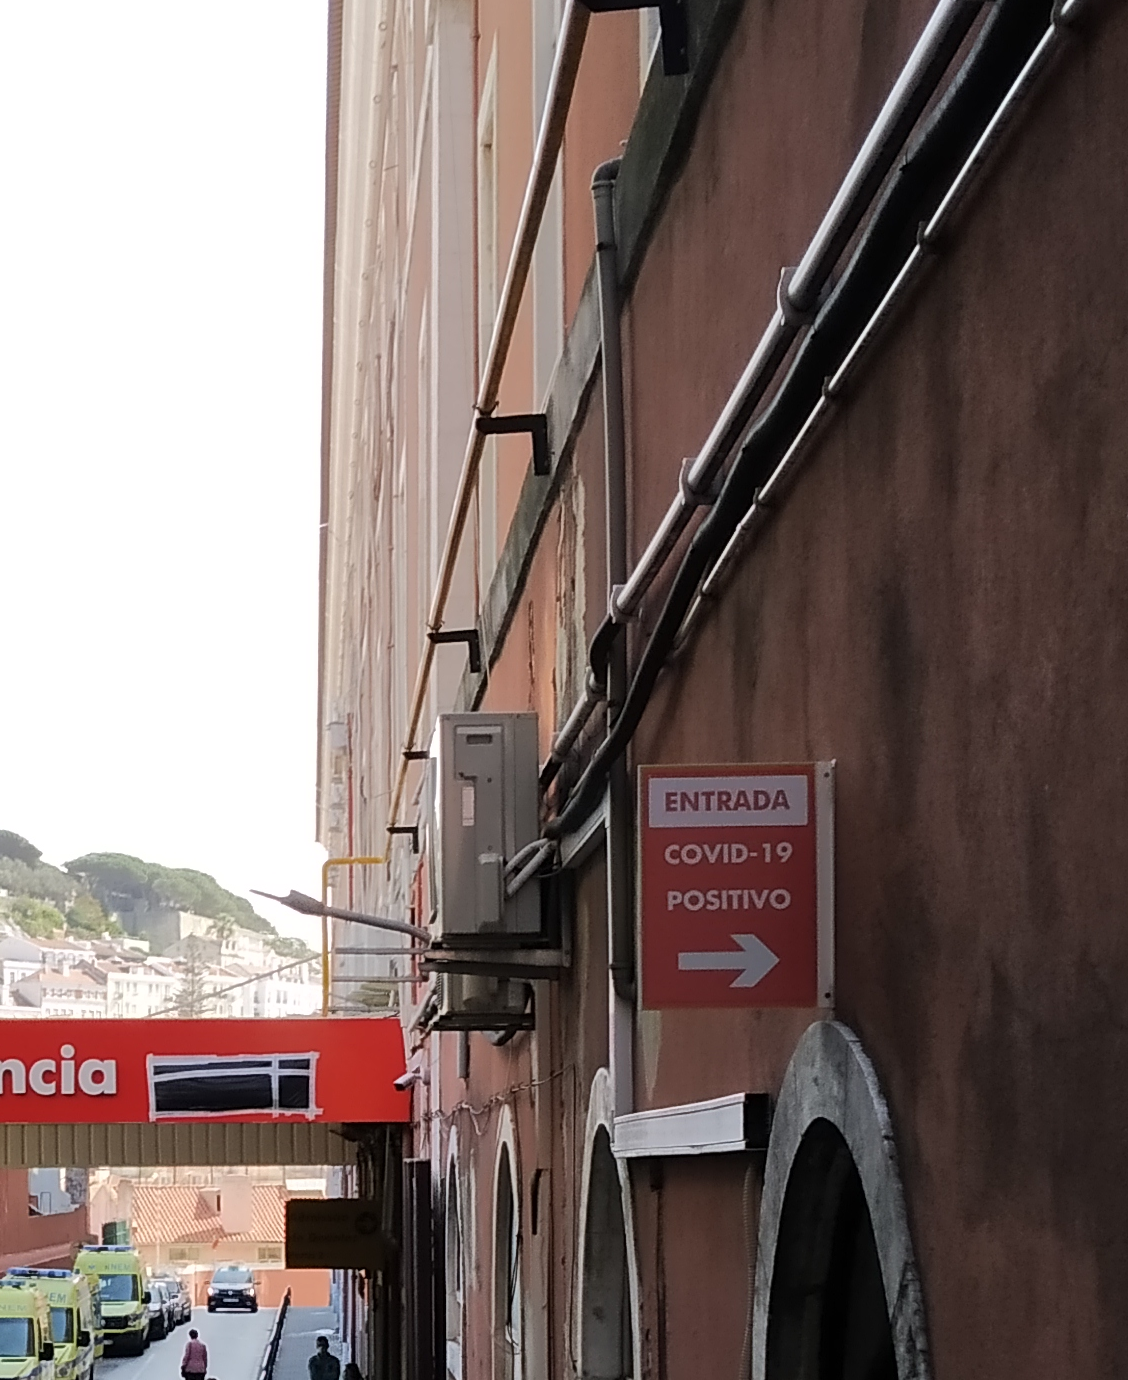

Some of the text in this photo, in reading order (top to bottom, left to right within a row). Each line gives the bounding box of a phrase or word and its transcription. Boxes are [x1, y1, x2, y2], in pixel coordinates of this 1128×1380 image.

[664, 789, 790, 812] ENTRADA
[664, 842, 793, 865] COVID-19
[667, 888, 792, 911] POSITIVO
[49, 1292, 67, 1303] EM
